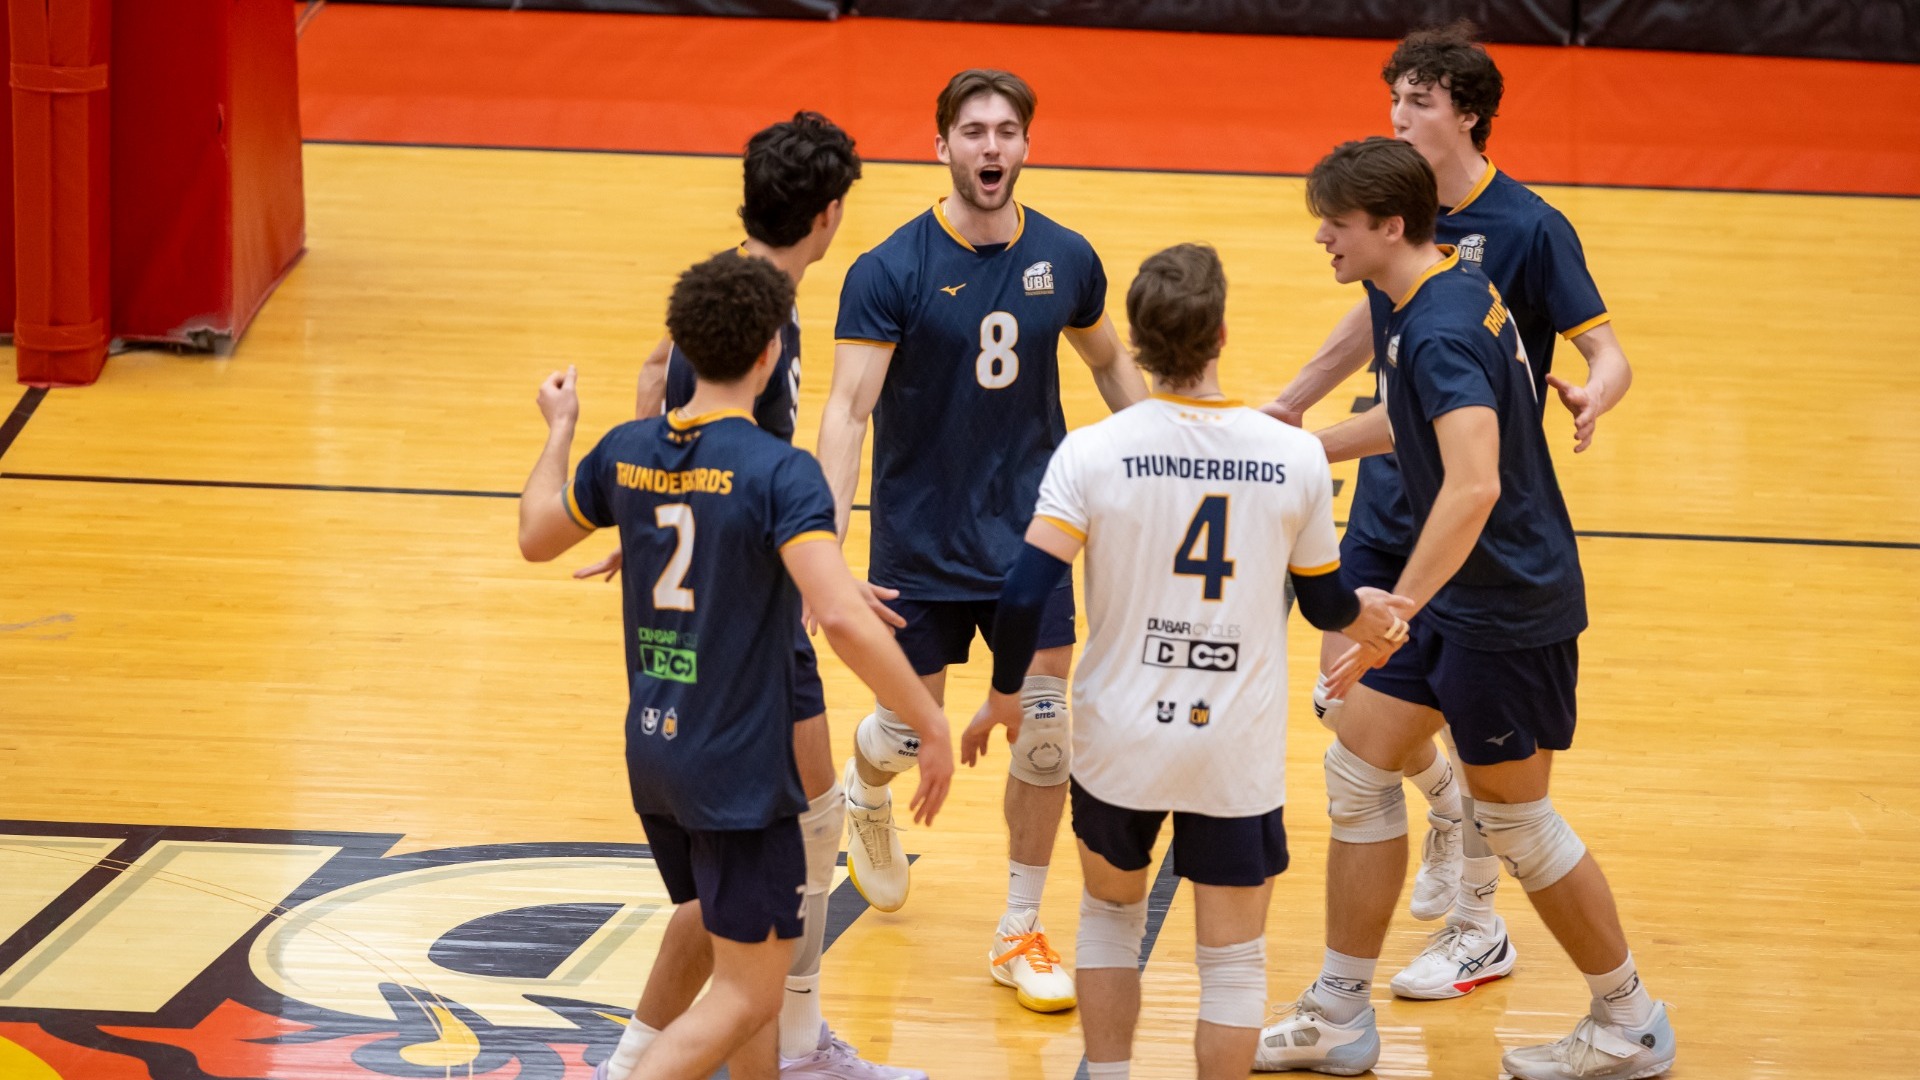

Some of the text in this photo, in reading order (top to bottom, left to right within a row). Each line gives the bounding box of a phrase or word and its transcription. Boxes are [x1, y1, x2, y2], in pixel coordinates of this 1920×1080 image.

[1023, 274, 1054, 291] UBC
[976, 311, 1019, 390] 8
[1123, 455, 1286, 484] THUNDERBIRDS
[652, 503, 696, 611] 2
[1173, 494, 1235, 602] 4
